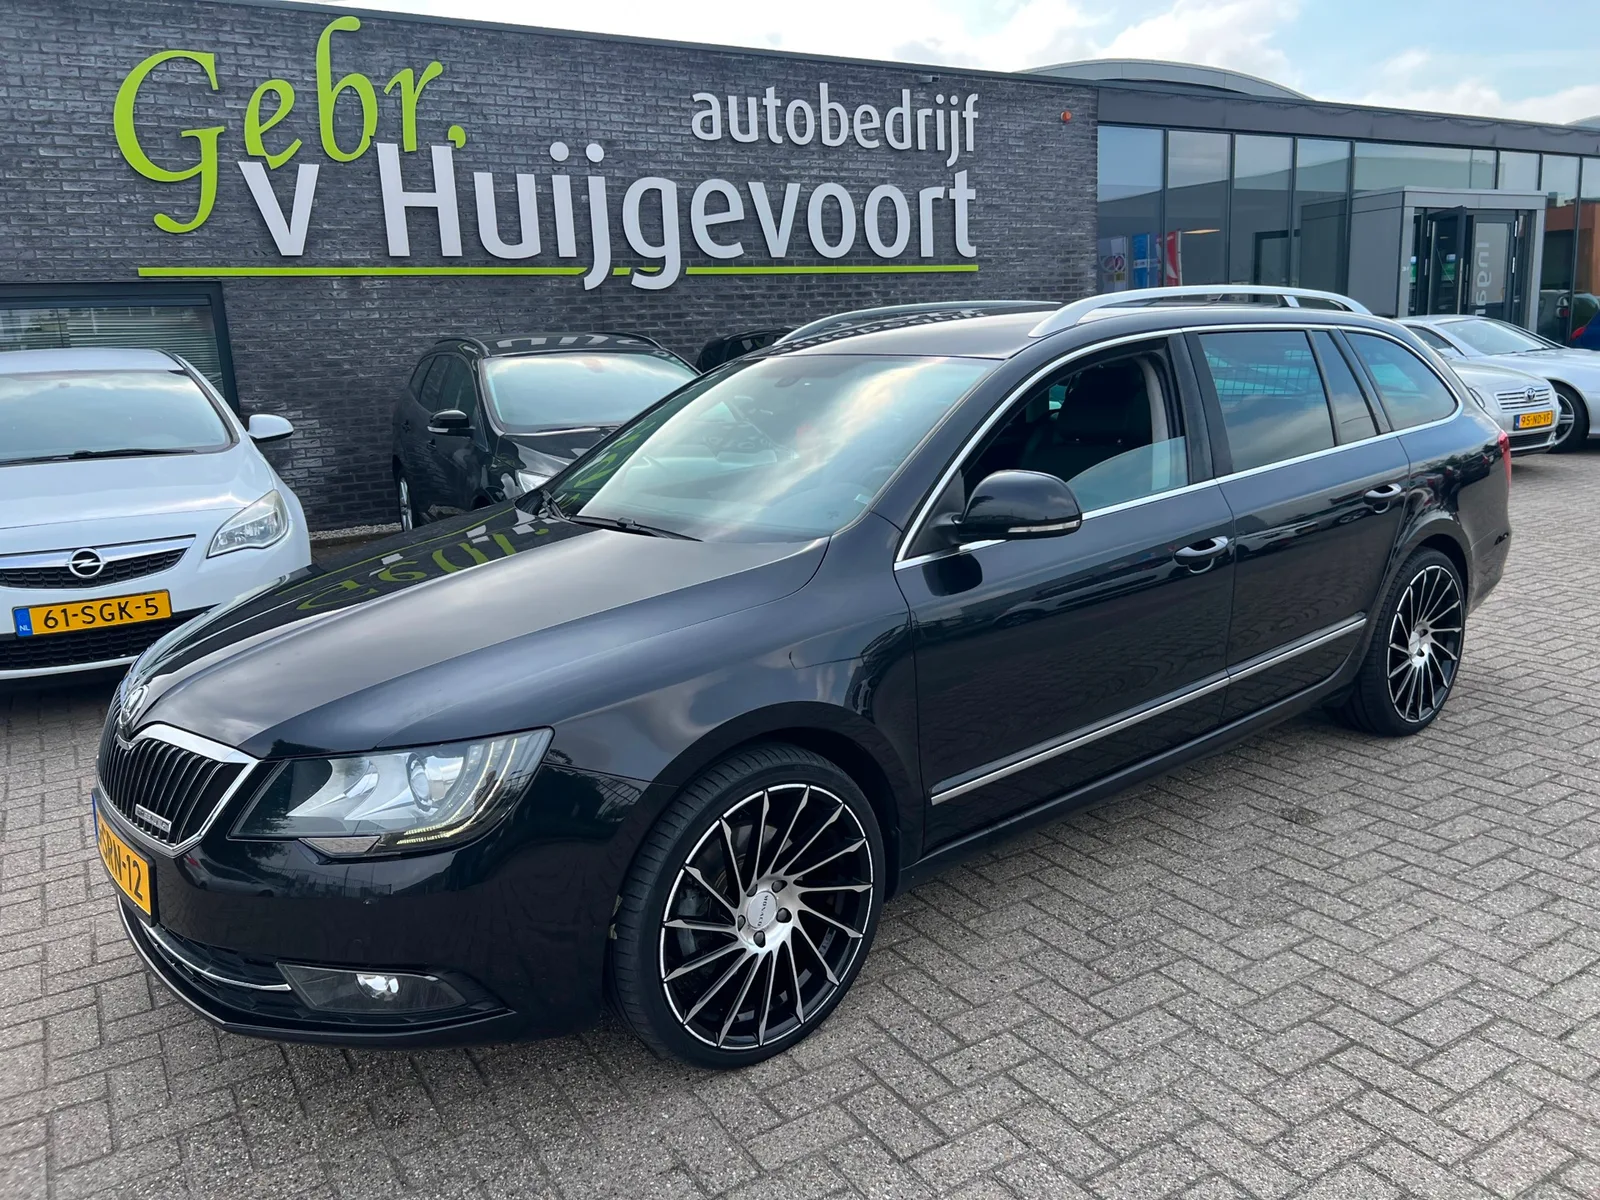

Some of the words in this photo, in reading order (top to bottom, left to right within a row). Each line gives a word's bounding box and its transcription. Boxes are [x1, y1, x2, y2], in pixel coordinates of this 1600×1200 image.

[113, 16, 467, 233] Gebr.
[691, 82, 979, 167] autobedrijf
[237, 161, 320, 256] v
[376, 141, 976, 290] Huijgevoort
[19, 625, 31, 633] NL
[43, 597, 159, 630] 61-SGK-5
[757, 894, 769, 927] MONACO
